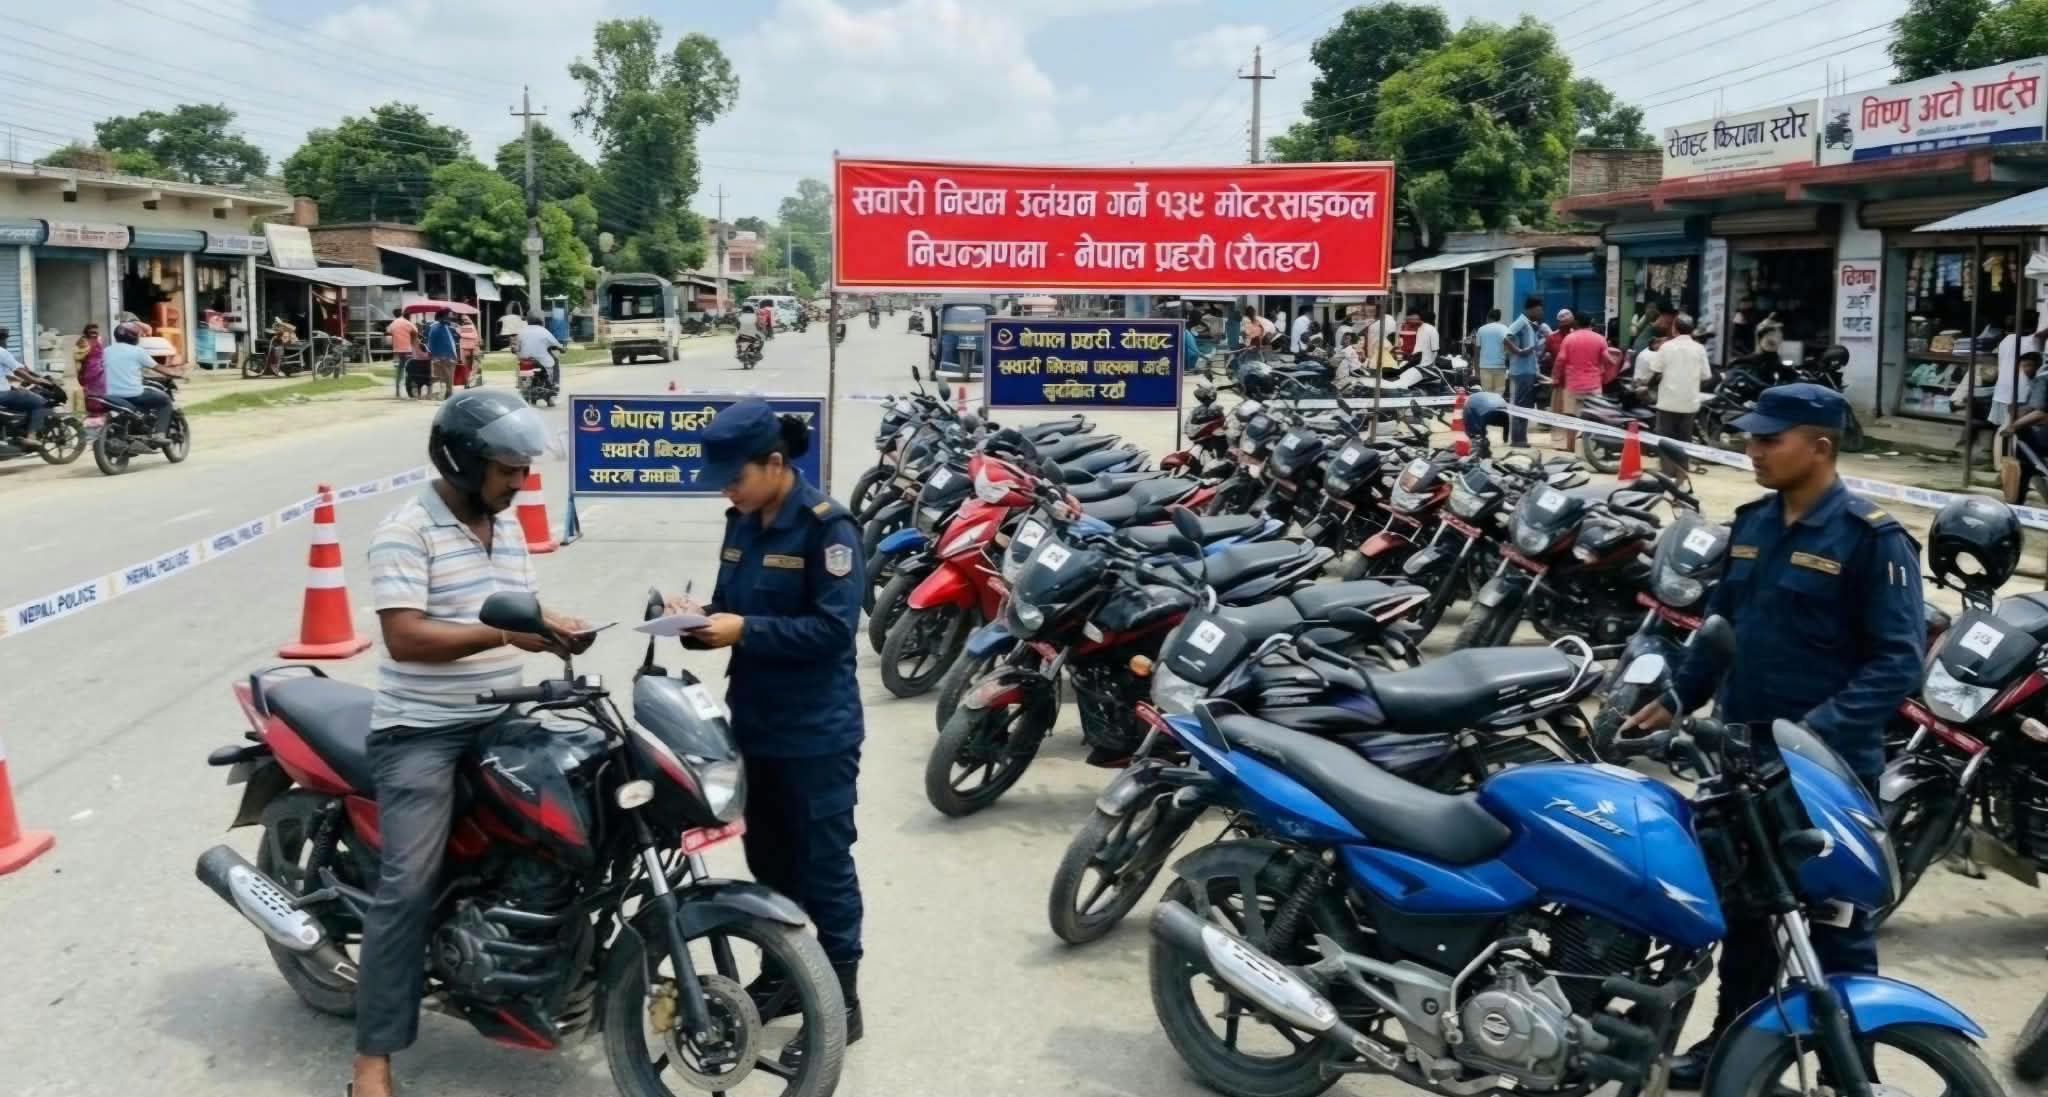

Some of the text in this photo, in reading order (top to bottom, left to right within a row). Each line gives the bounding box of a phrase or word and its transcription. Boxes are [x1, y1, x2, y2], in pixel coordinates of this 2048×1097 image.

[1770, 107, 1810, 142] स्टोर
[1861, 95, 1912, 133] विष्णु
[1919, 81, 1965, 121] अटो
[852, 180, 926, 216] सवारी
[934, 178, 1008, 216] नियम
[1015, 184, 1097, 217] उलंघन
[1105, 182, 1149, 218] गर्ने
[1214, 184, 1376, 222] मोटरसाइकल
[907, 230, 1048, 268] नियन्त्रणमा
[1074, 233, 1147, 269] नेपाल
[1154, 234, 1216, 272] प्रहरी
[1225, 233, 1320, 272] (रौतहट)
[609, 404, 664, 429] नेपाल
[19, 584, 97, 626] NEPAL POLICE
